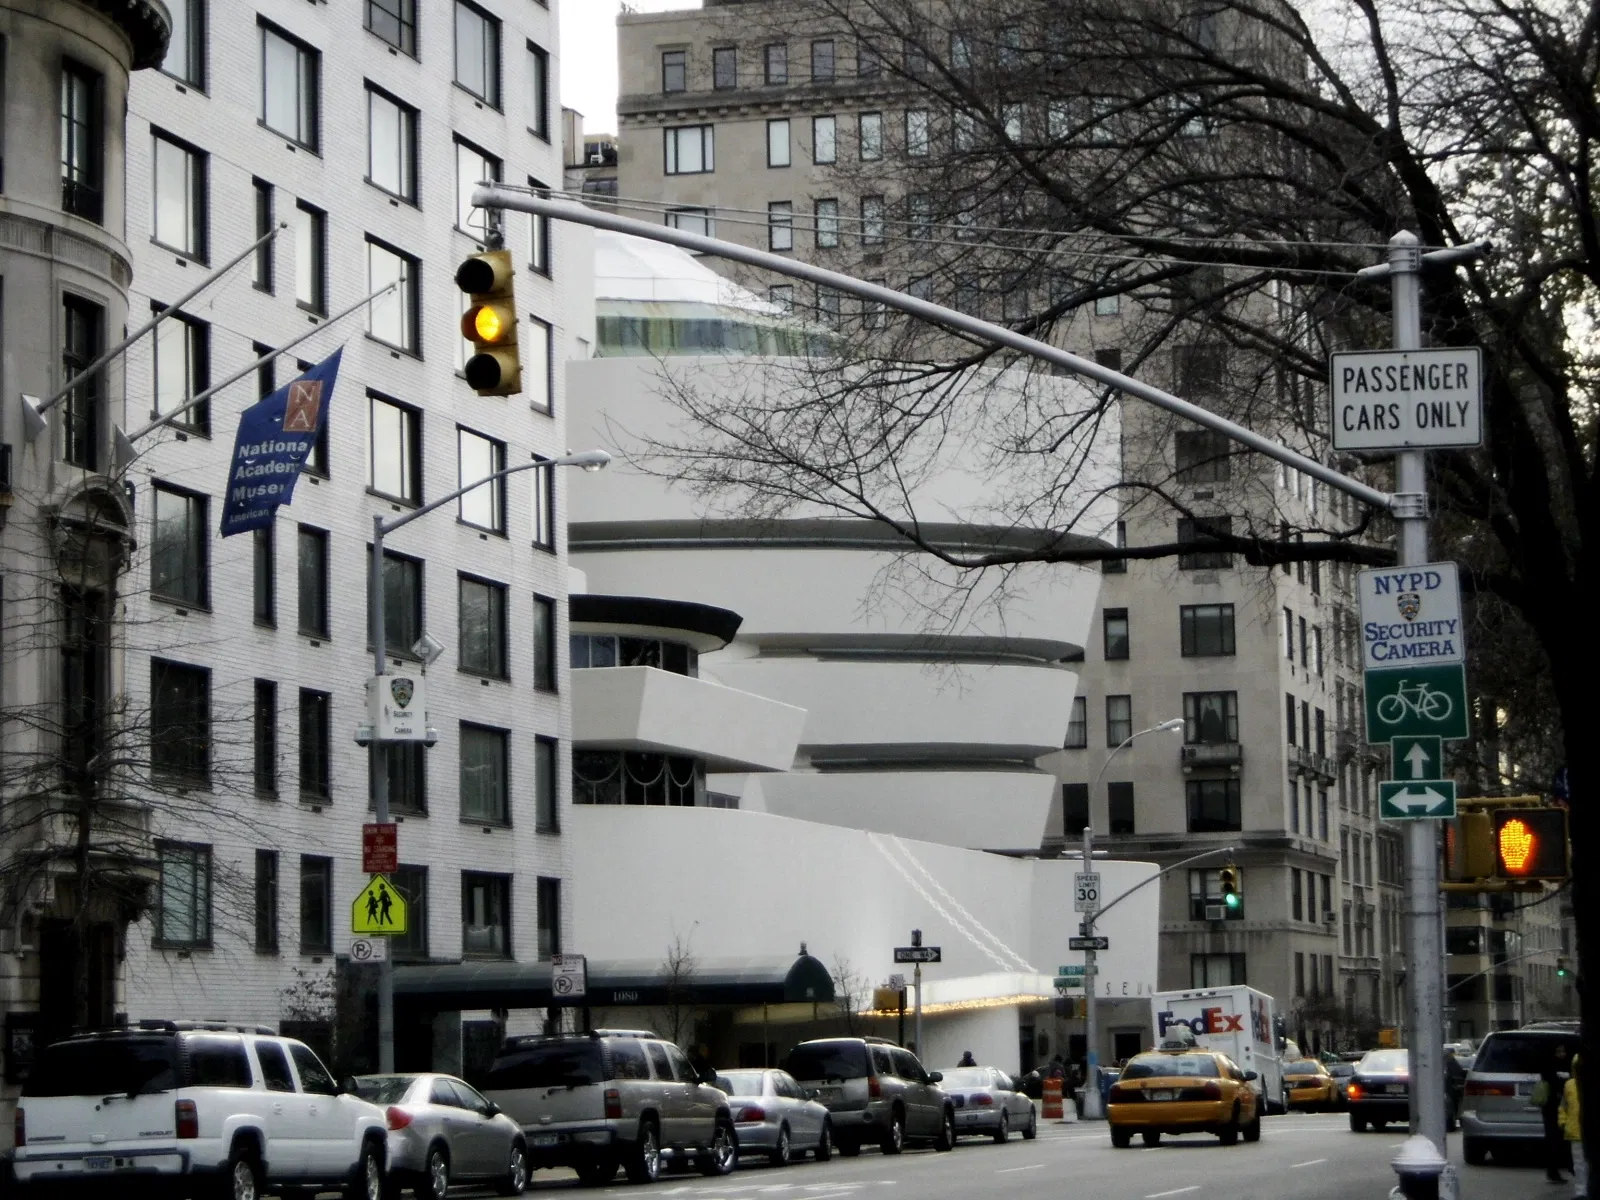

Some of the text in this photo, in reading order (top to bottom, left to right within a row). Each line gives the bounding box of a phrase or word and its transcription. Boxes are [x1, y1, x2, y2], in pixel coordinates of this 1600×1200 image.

[1343, 363, 1468, 393] PASSENGER
[1343, 401, 1469, 431] CARS ONLY
[1374, 572, 1442, 595] NYPD
[1364, 619, 1457, 642] SECURITY
[1371, 640, 1455, 661] CAMERA
[1077, 888, 1097, 901] 30
[612, 991, 638, 1002] 1080
